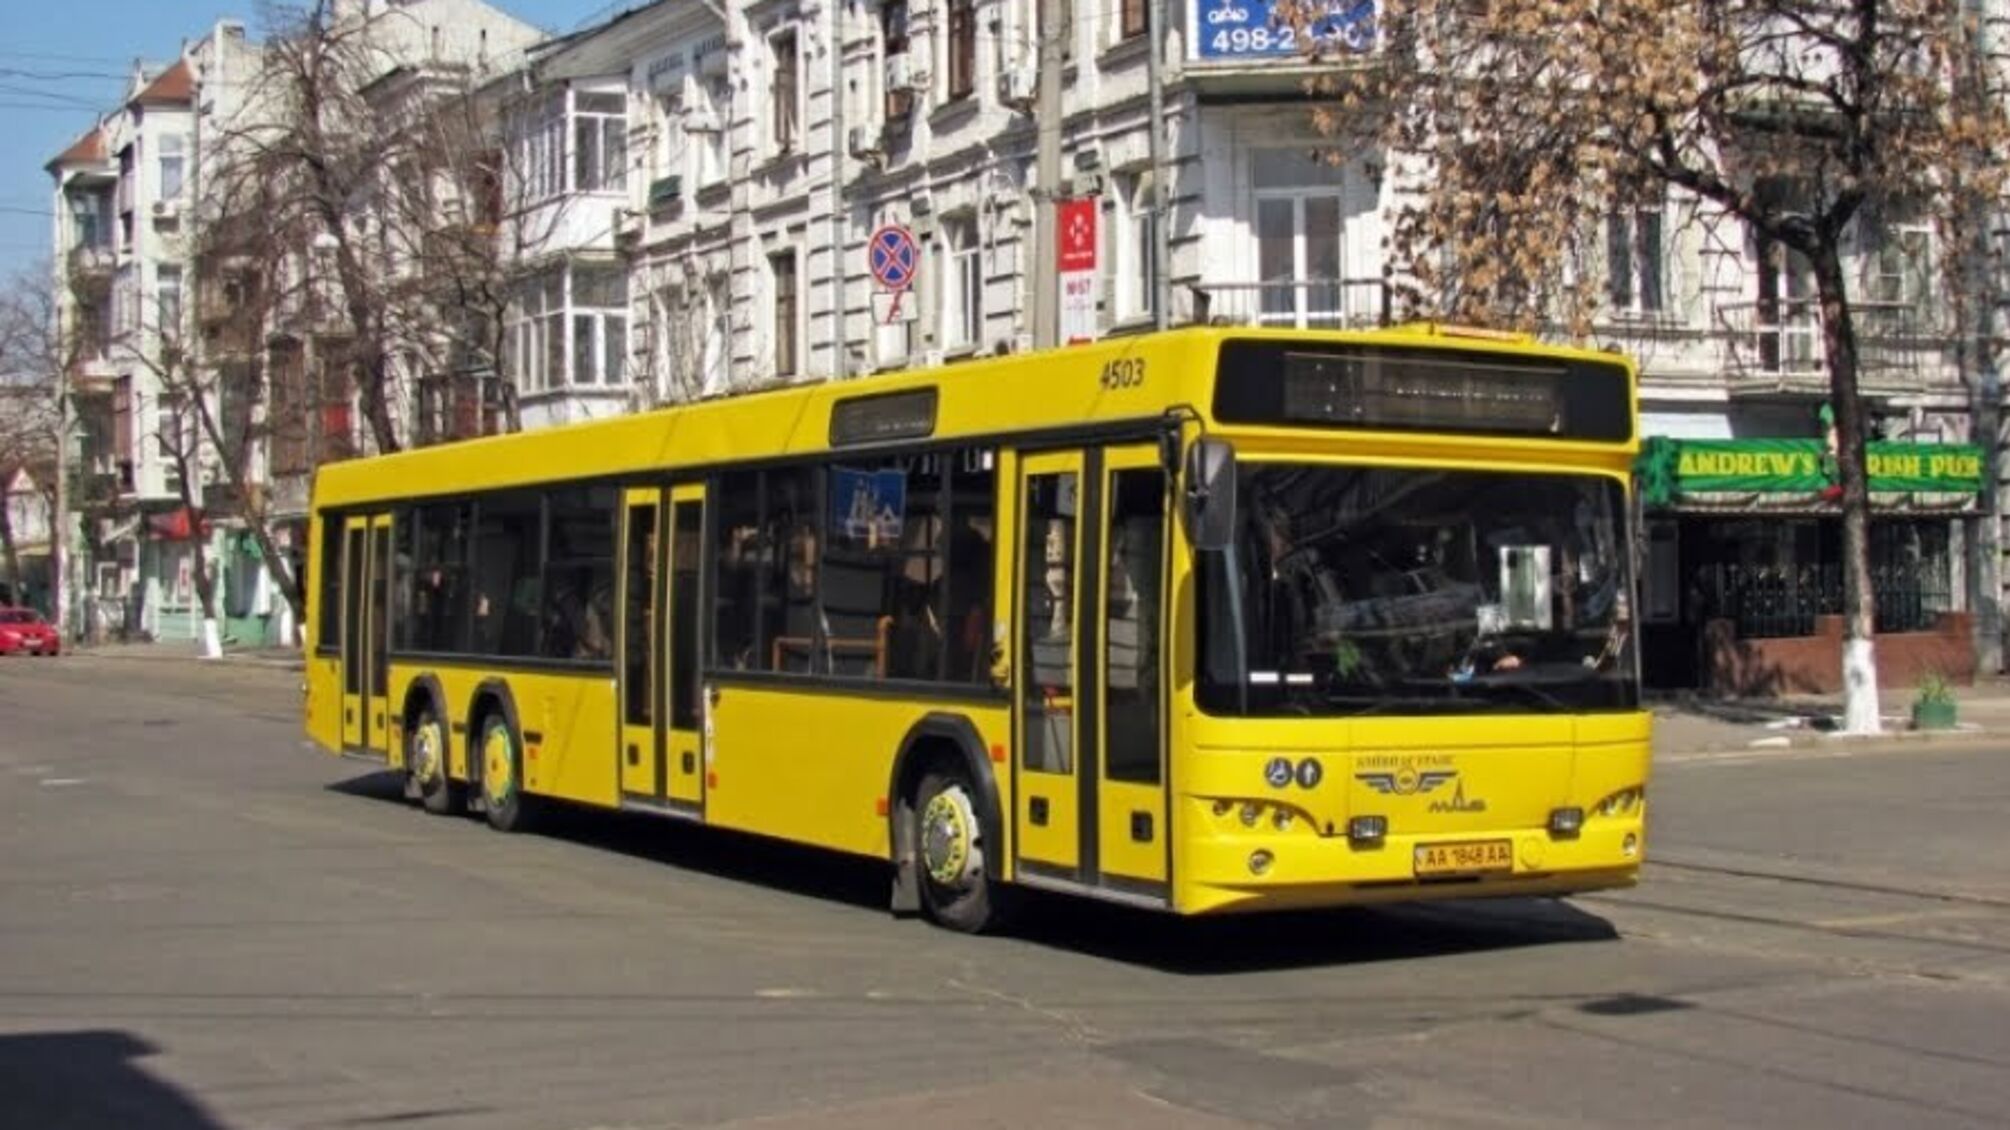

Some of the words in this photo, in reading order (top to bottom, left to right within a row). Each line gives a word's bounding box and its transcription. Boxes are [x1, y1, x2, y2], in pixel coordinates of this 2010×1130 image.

[1101, 357, 1145, 390] 4503
[1678, 452, 1815, 476] ANDREW'S
[1866, 453, 1919, 477] RISH
